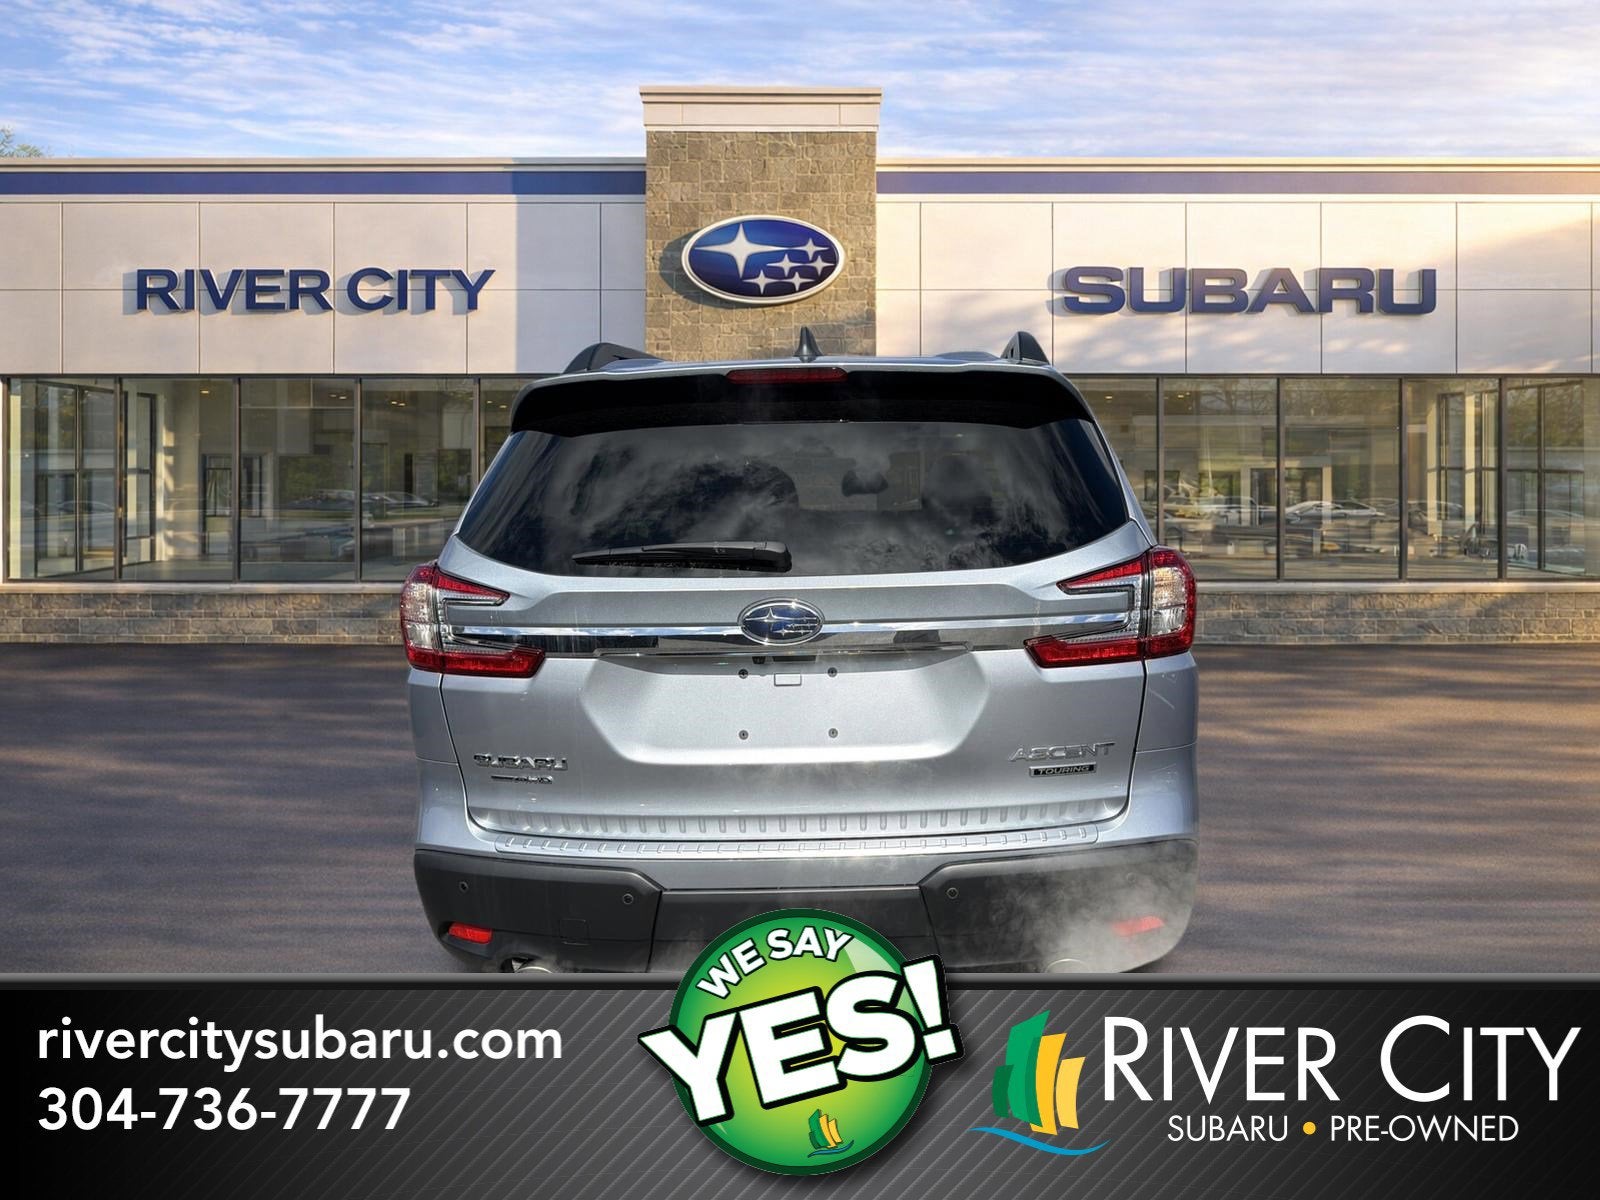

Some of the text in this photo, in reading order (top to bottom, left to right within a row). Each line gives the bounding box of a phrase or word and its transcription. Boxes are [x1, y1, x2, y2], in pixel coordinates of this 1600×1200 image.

[136, 267, 495, 311] RIVER CITY
[1063, 266, 1437, 315] SUBARU
[1008, 741, 1116, 762] ASCENT
